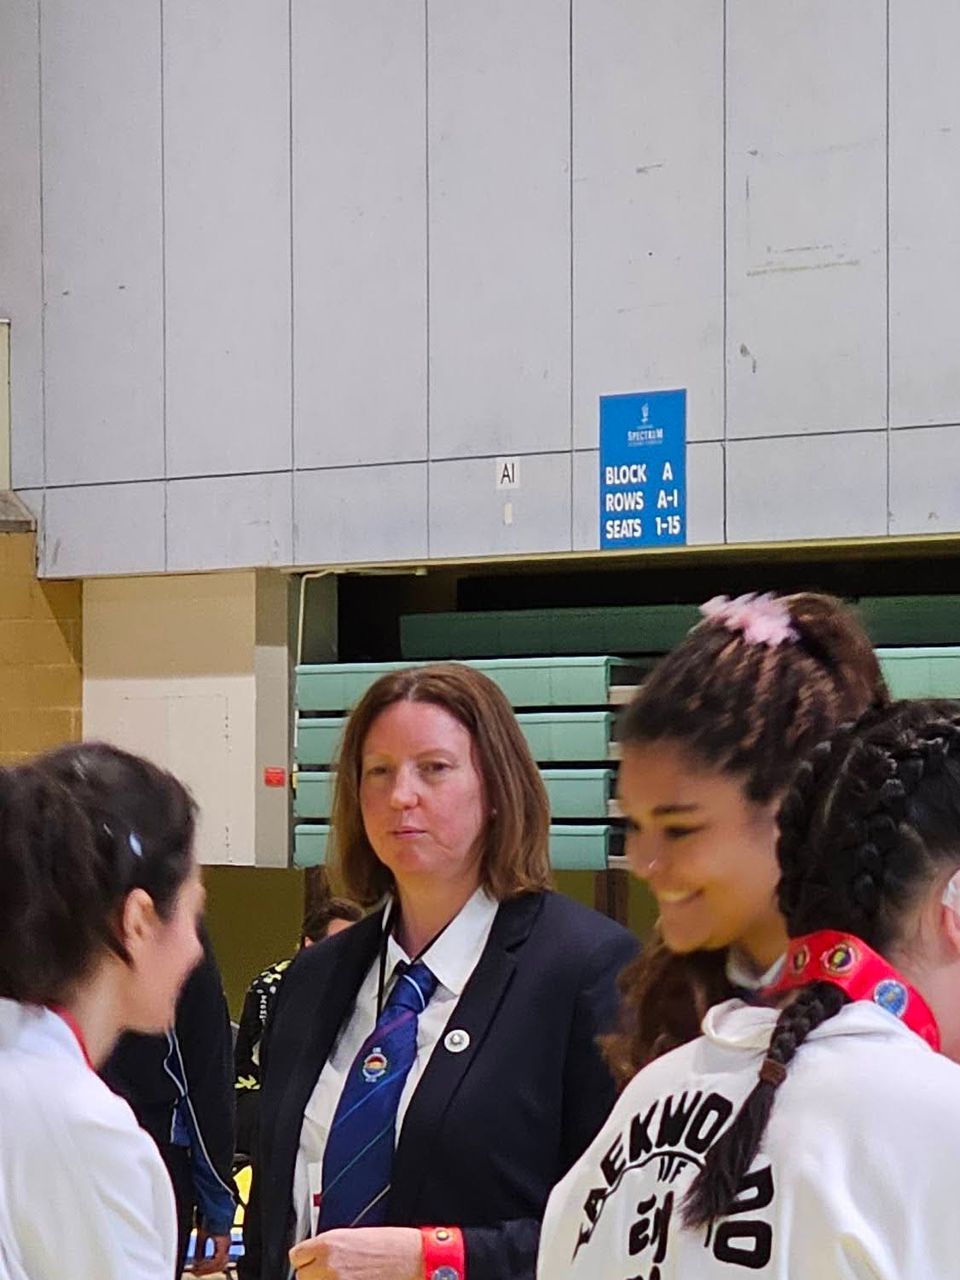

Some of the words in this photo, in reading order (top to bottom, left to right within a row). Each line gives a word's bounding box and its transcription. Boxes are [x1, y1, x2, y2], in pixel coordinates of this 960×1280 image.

[605, 463, 647, 486] BLOCK
[662, 461, 673, 481] A
[605, 490, 644, 513] ROWS
[605, 518, 642, 540] SEATS
[655, 515, 681, 536] 1-15
